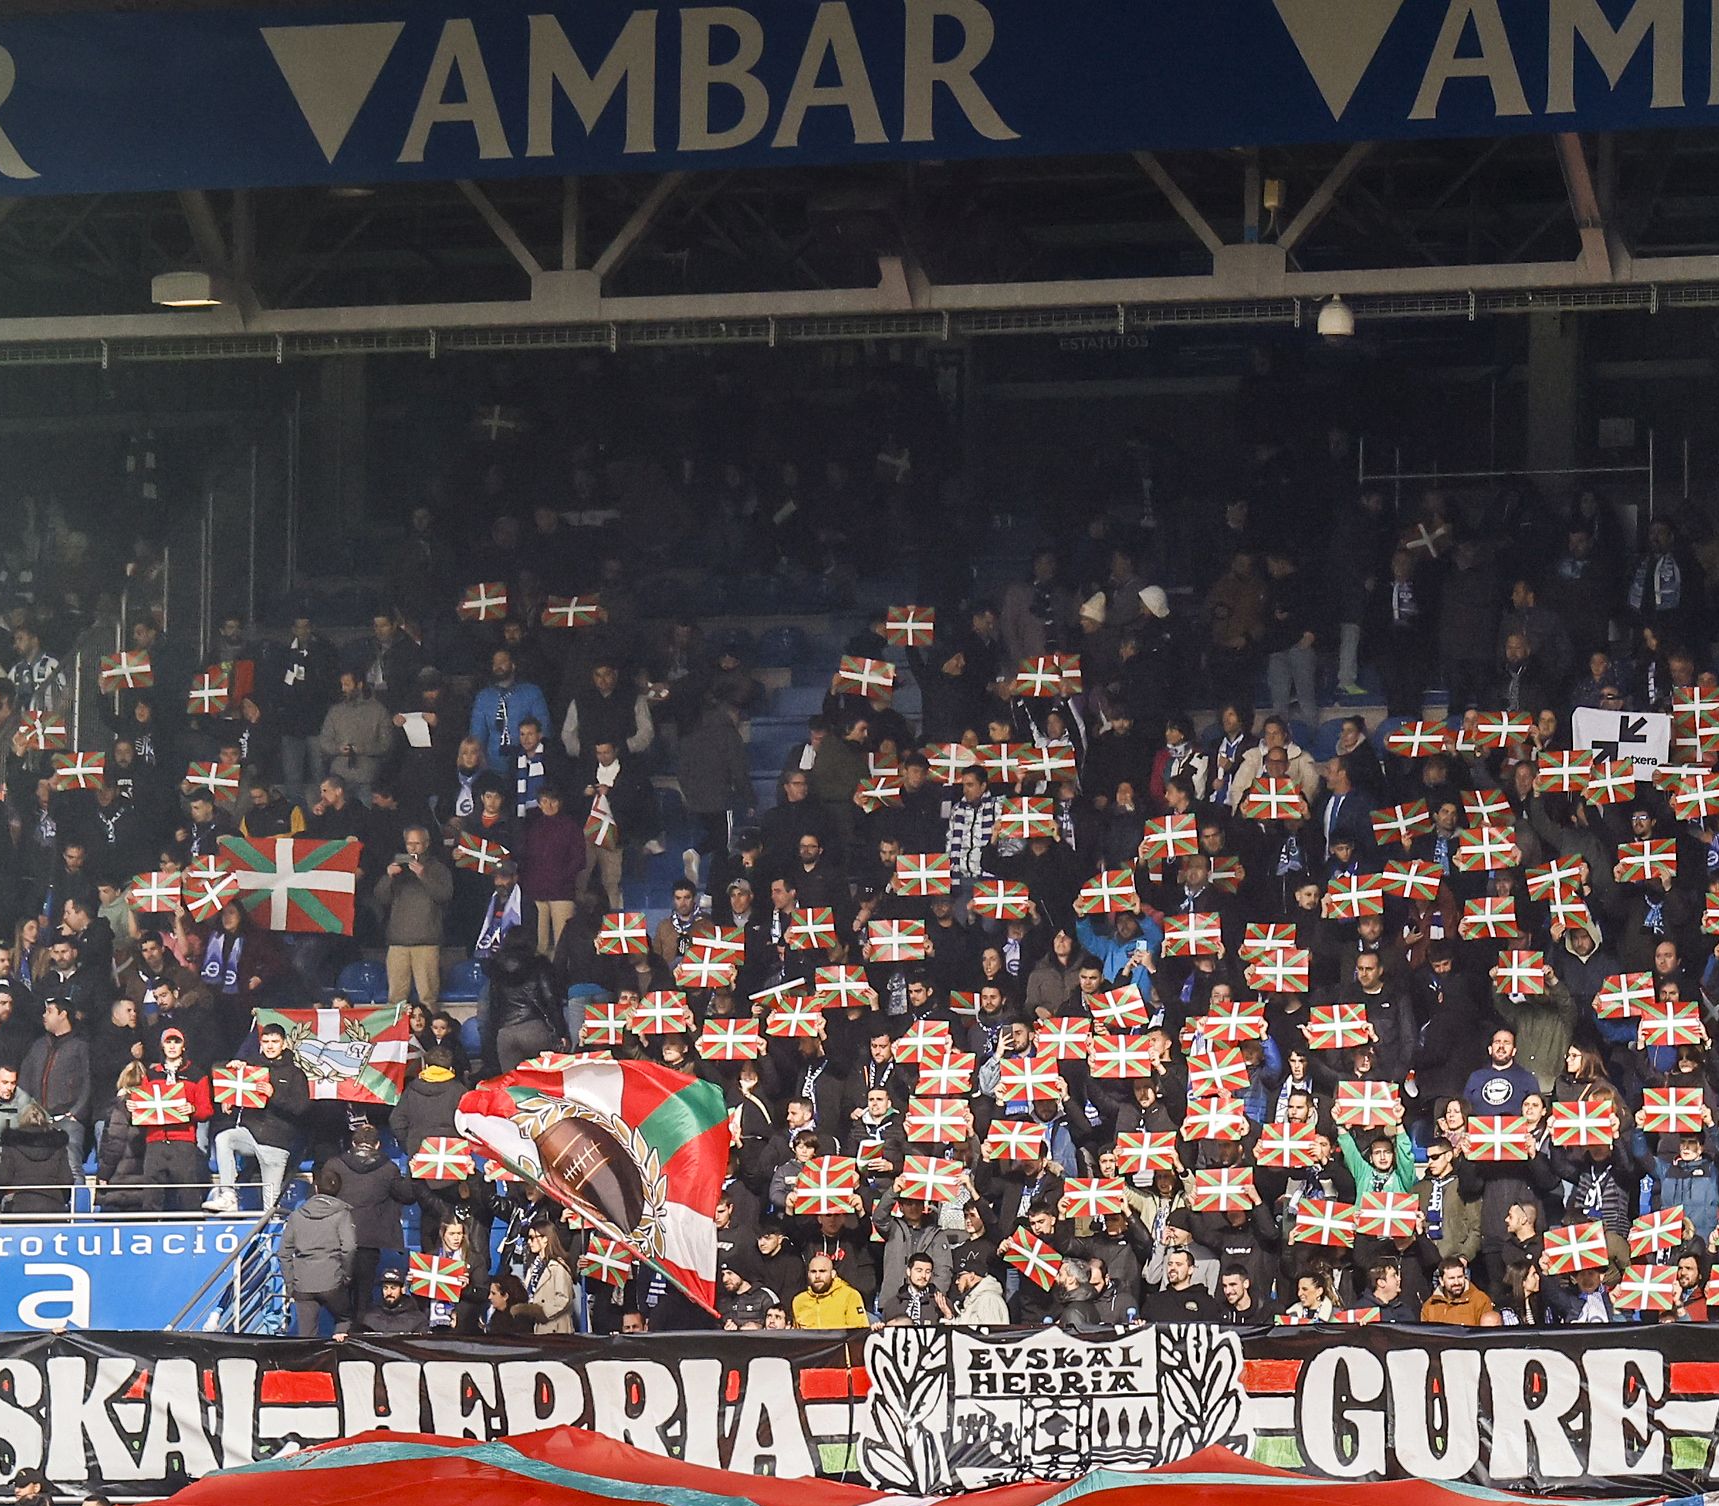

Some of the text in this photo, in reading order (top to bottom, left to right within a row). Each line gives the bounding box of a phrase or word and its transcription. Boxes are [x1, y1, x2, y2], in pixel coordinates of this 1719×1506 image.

[397, 0, 1023, 163] AMBAR
[1060, 335, 1149, 351] ESTATUTOS
[338, 1358, 816, 1480] HERRIA
[1300, 1346, 1666, 1480] GURE
